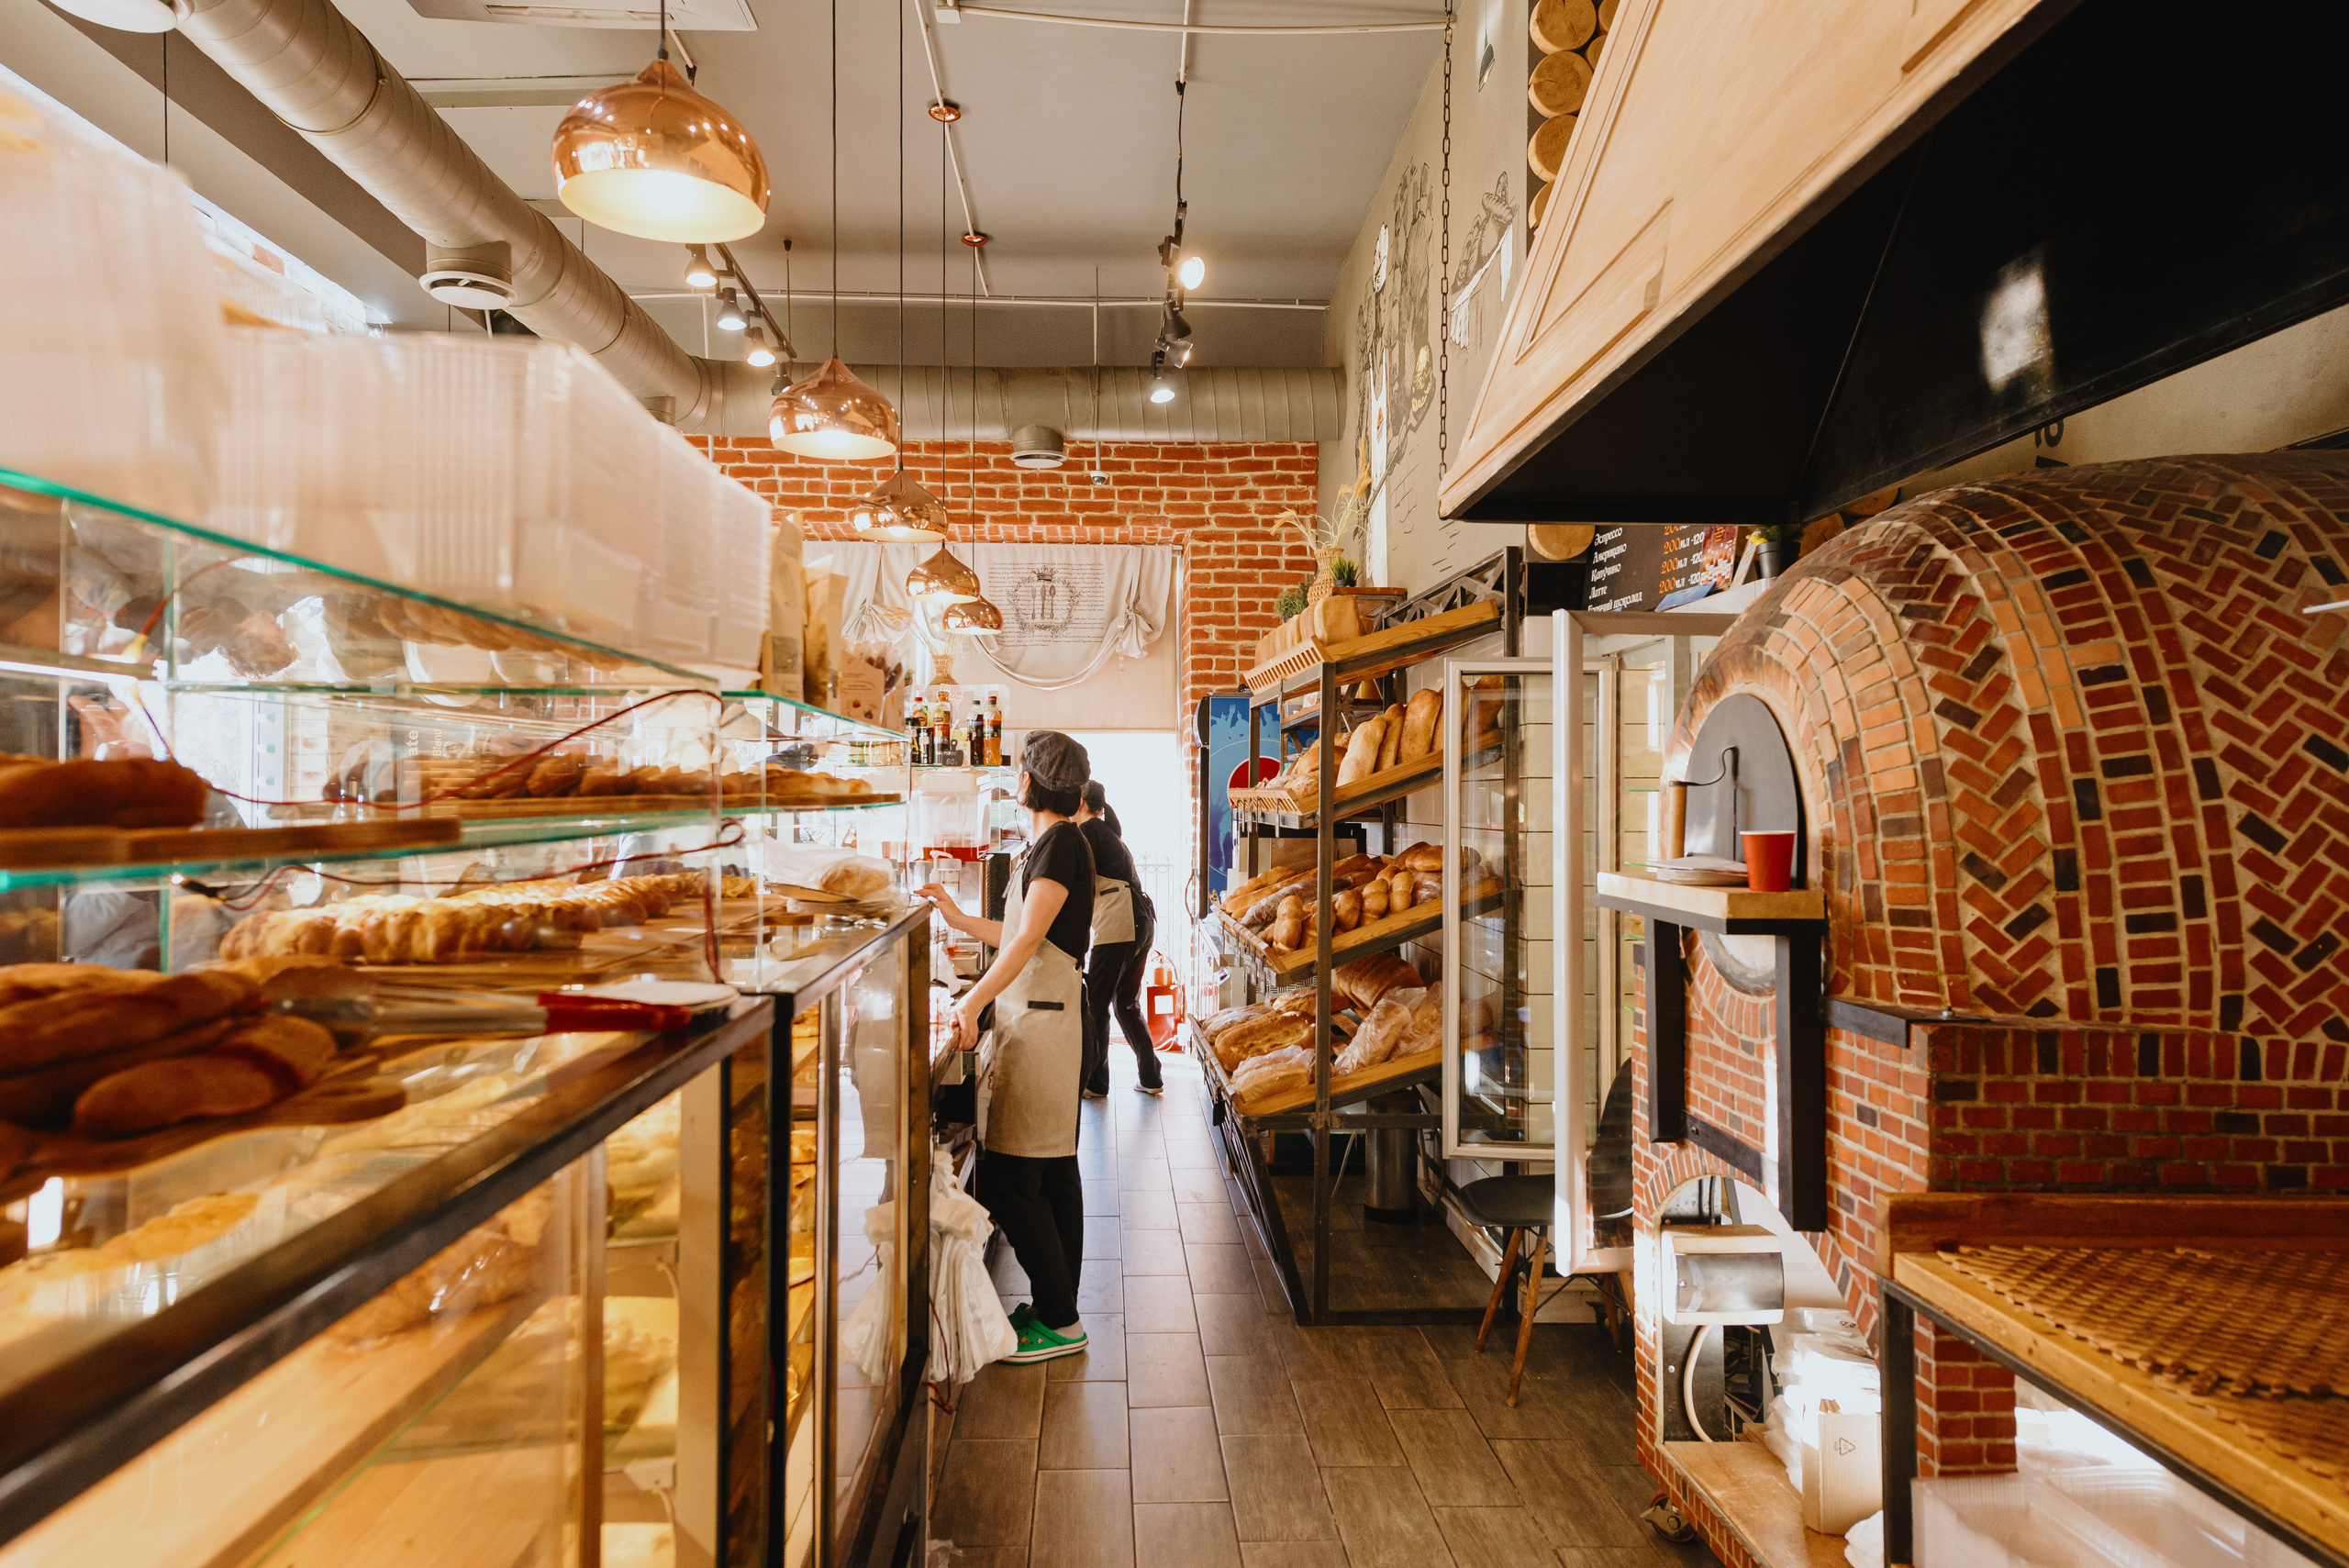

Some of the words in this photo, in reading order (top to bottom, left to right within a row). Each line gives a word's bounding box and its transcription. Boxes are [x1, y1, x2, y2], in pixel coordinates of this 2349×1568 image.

[1595, 527, 1623, 546] Эспрессо
[1593, 543, 1627, 563] Американо
[1591, 562, 1621, 582] Капучино
[1589, 584, 1608, 599] Латте
[1614, 591, 1643, 607] шоколад
[432, 728, 443, 756] Blend
